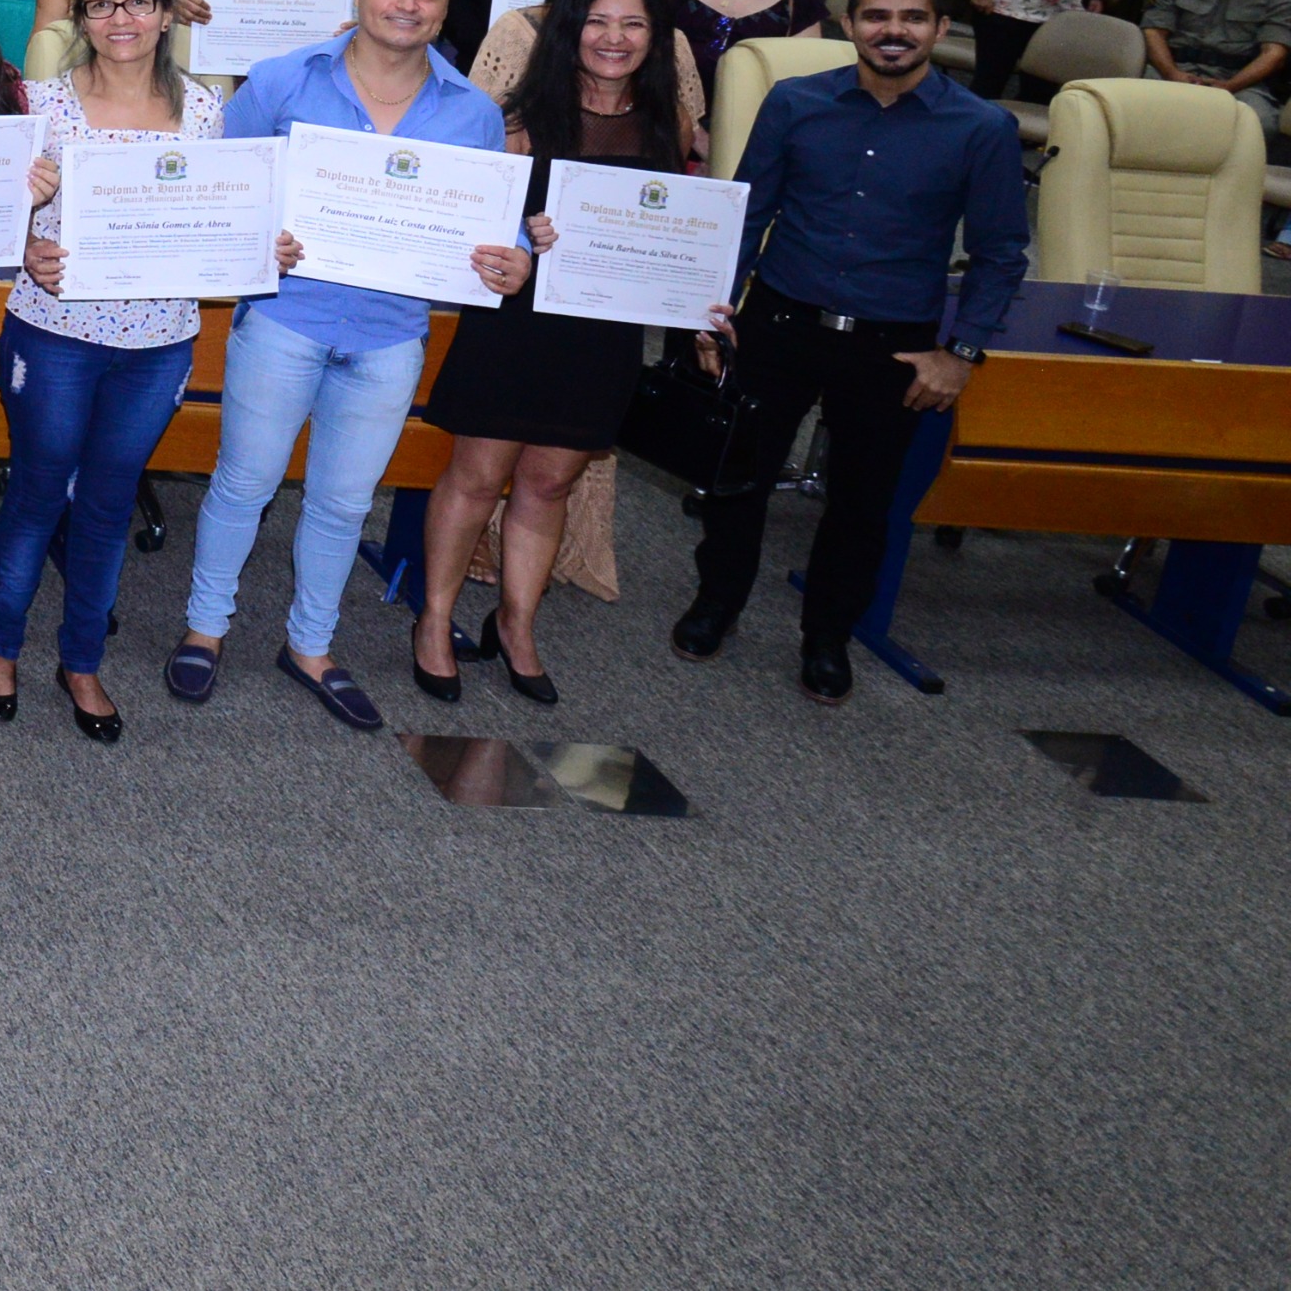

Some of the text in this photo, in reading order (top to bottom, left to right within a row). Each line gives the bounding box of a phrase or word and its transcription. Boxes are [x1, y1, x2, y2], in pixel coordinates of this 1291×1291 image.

[108, 222, 133, 231] Maria
[134, 222, 160, 230] Sônia
[162, 221, 191, 229] Gomes
[206, 220, 232, 228] Abreu
[319, 206, 466, 237] Franciosvan Luiz Costa Oliveira
[589, 240, 614, 251] Ivânia
[615, 244, 648, 256] Barbosa
[659, 251, 679, 260] Silva
[679, 254, 697, 263] Cruz
